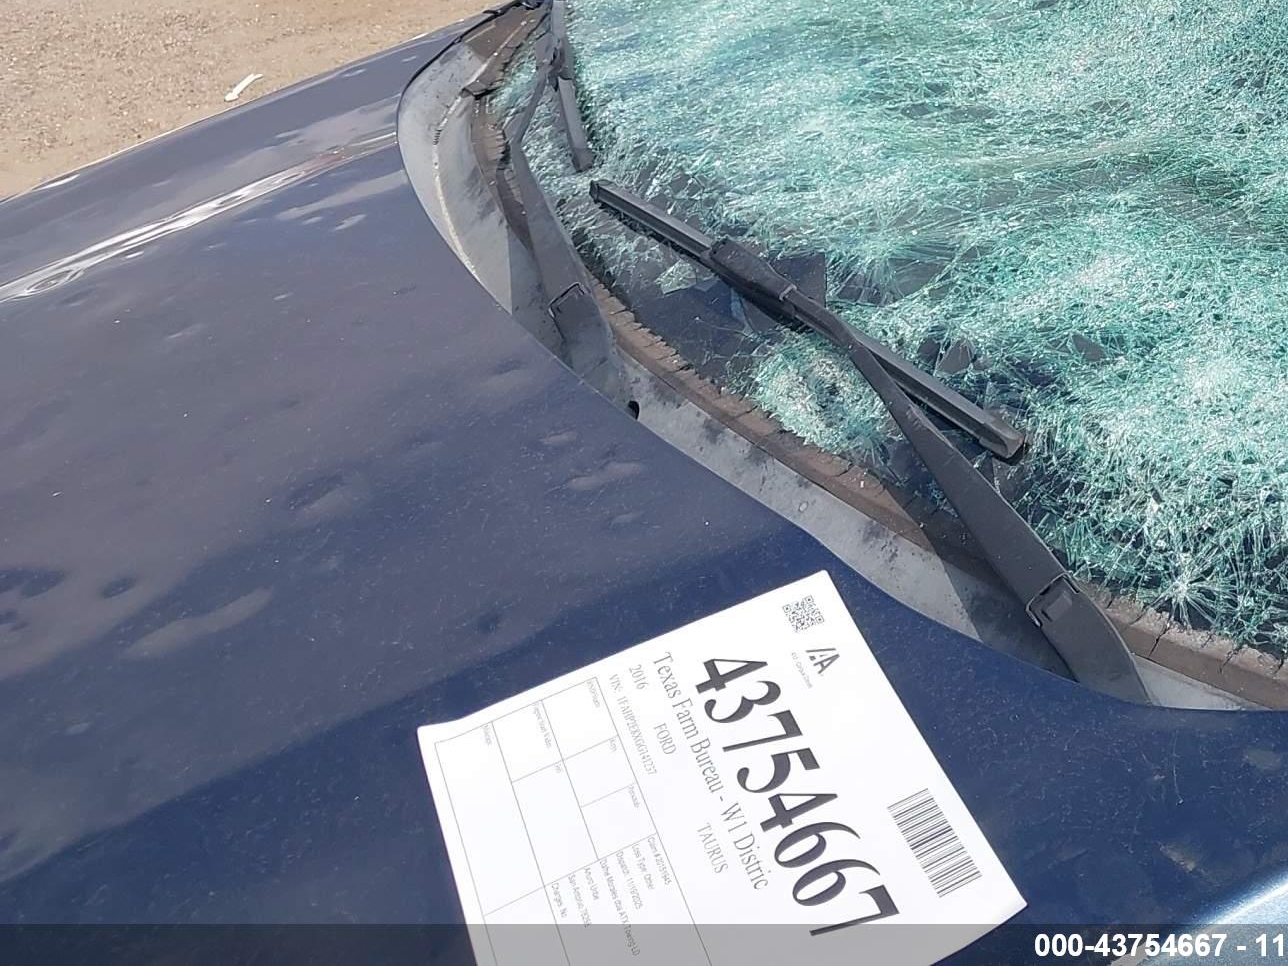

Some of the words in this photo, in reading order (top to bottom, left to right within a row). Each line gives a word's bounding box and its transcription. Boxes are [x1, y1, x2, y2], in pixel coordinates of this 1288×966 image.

[653, 651, 683, 700] Texas
[672, 698, 703, 741] Farm
[629, 663, 650, 690] 2016
[653, 722, 677, 755] FORD
[697, 822, 729, 874] TAURUS
[690, 739, 724, 794] Bureau
[695, 658, 900, 937] 43754667
[720, 800, 748, 834] W1
[733, 832, 770, 891] Distric
